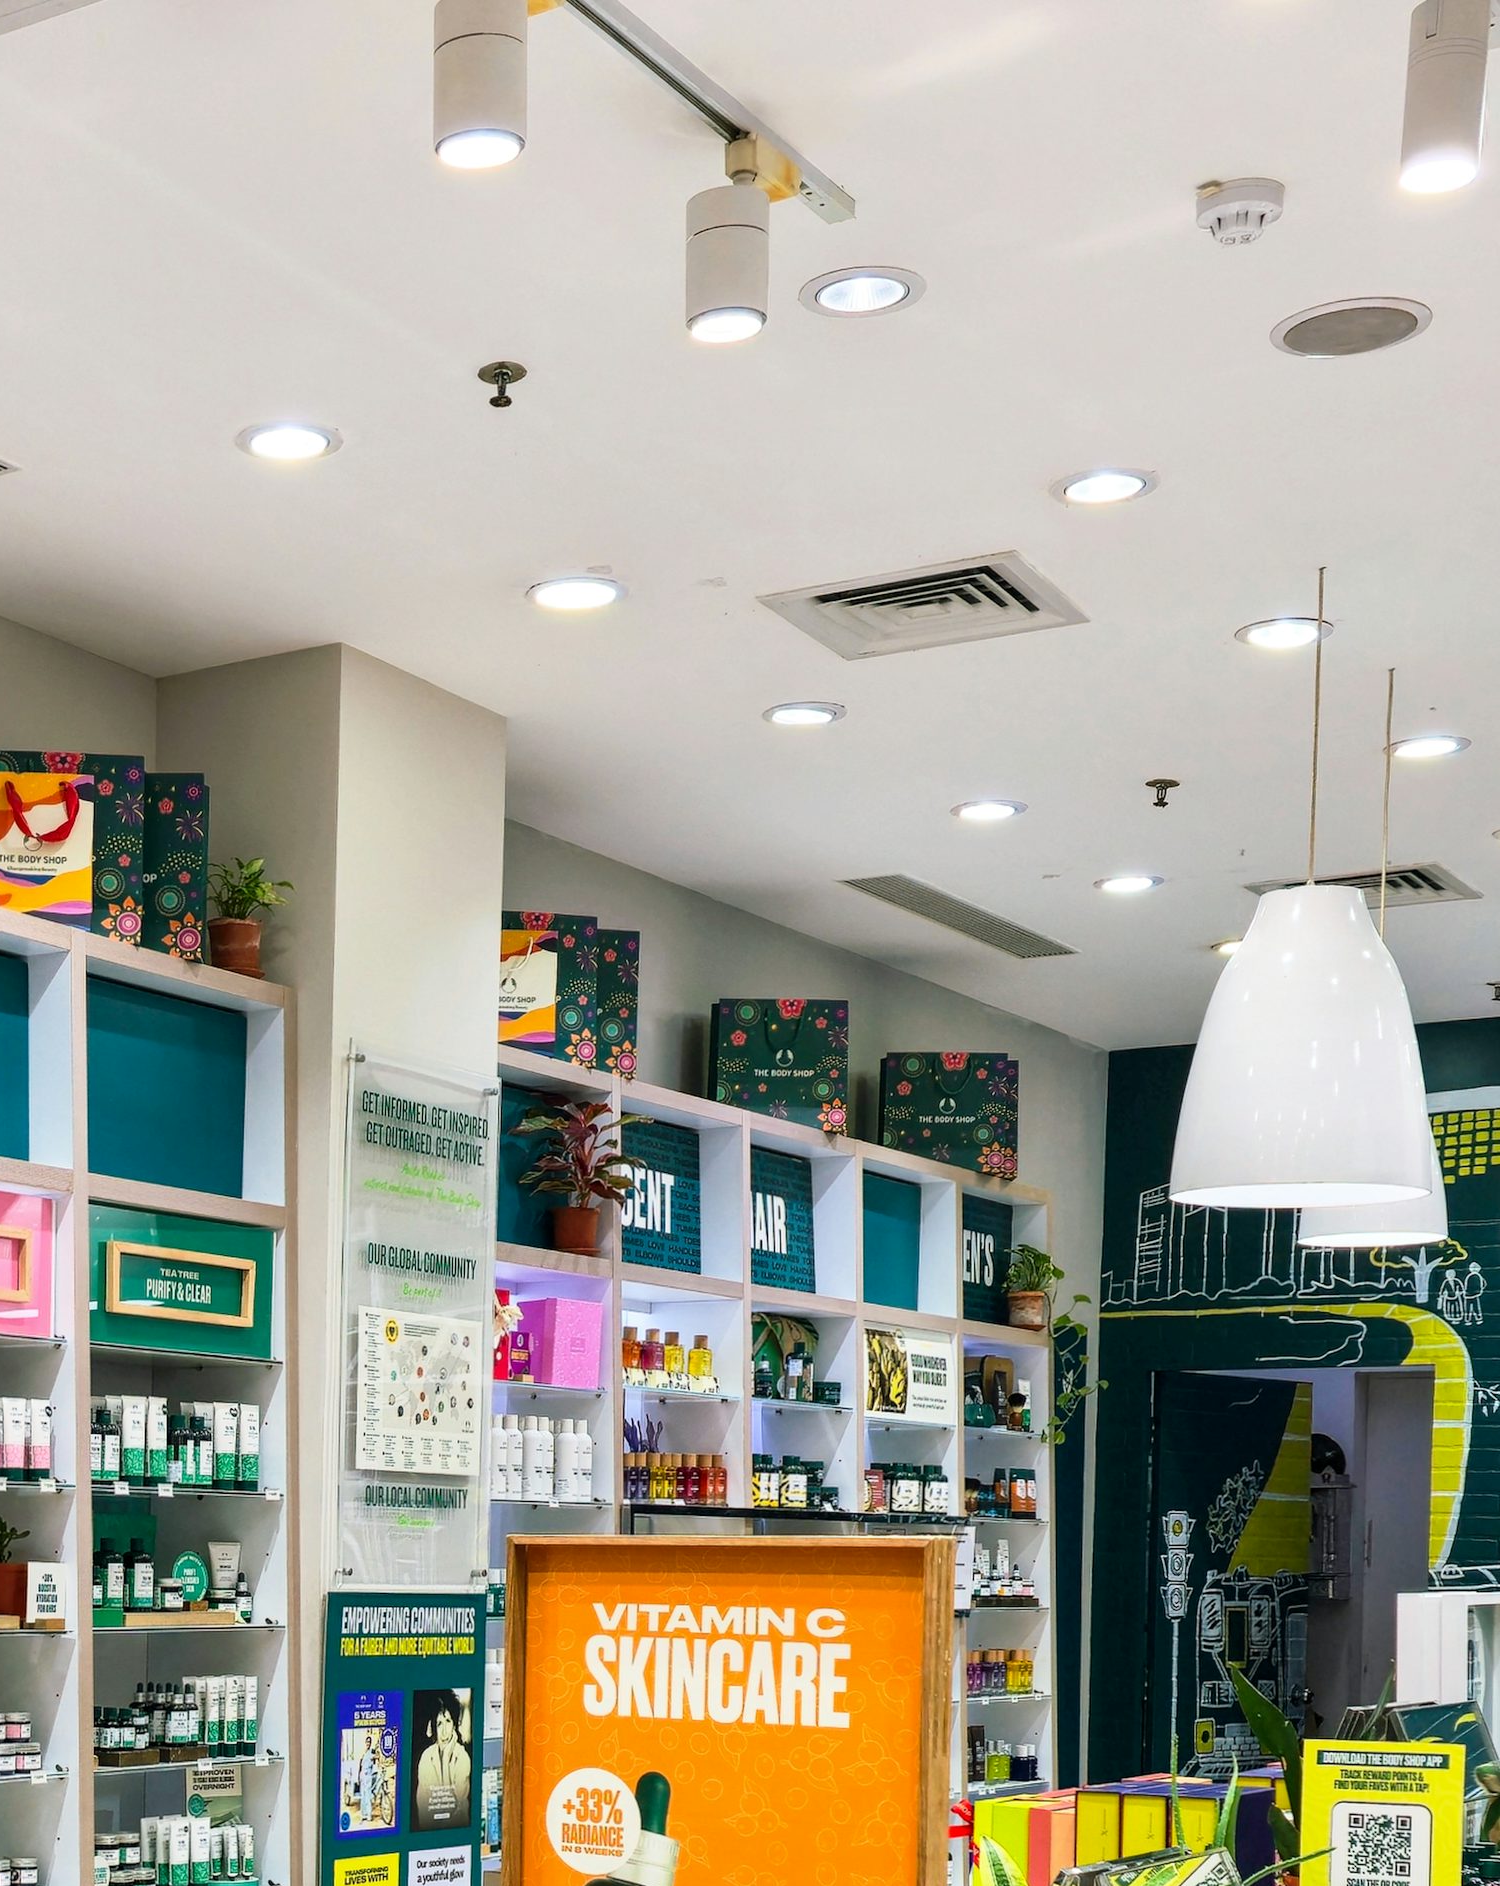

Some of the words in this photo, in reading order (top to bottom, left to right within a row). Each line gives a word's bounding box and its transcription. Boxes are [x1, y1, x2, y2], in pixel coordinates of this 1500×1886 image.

[18, 855, 41, 864] BODY
[43, 856, 67, 865] SHOP
[754, 1068, 768, 1077] THE
[771, 1069, 791, 1077] BODY
[794, 1069, 815, 1077] SHOP
[363, 1091, 379, 1113] GET
[381, 1095, 429, 1125] INFORMED.
[432, 1107, 448, 1129] GET
[450, 1111, 490, 1140] INSPIRED.
[367, 1122, 383, 1143] GET
[386, 1125, 434, 1155] OUTRAGED.
[436, 1138, 452, 1159] GET
[453, 1140, 484, 1166] ACTIVE.
[621, 1163, 674, 1234] CENT
[368, 1243, 386, 1266] OUR
[389, 1246, 422, 1272] GLOBAL
[424, 1252, 477, 1279] COMMUNITY
[963, 1229, 994, 1287] EN'S
[160, 1269, 176, 1279] TEA
[177, 1270, 199, 1280] TREE
[146, 1278, 176, 1302] PURIFY
[177, 1282, 184, 1302] &
[185, 1281, 212, 1306] CLEAR
[342, 1606, 410, 1634] EMPOWERING
[410, 1607, 475, 1634] COMMUNITIES
[592, 1602, 796, 1638] VITAMIN
[805, 1608, 846, 1638] C
[583, 1636, 850, 1728] SKINCARE
[1323, 1752, 1367, 1765] DOWNLOAD
[1368, 1753, 1381, 1766] THE
[1382, 1753, 1403, 1766] BODY
[1404, 1755, 1426, 1766] SHOP
[1427, 1755, 1443, 1767] APP
[563, 1788, 622, 1824] +33%
[562, 1823, 624, 1848] RADIANCE
[345, 1866, 388, 1876] TRANSFORMING
[429, 1858, 448, 1869] society
[450, 1855, 465, 1864] needs
[345, 1875, 366, 1885] LIVES
[368, 1873, 388, 1883] WITH
